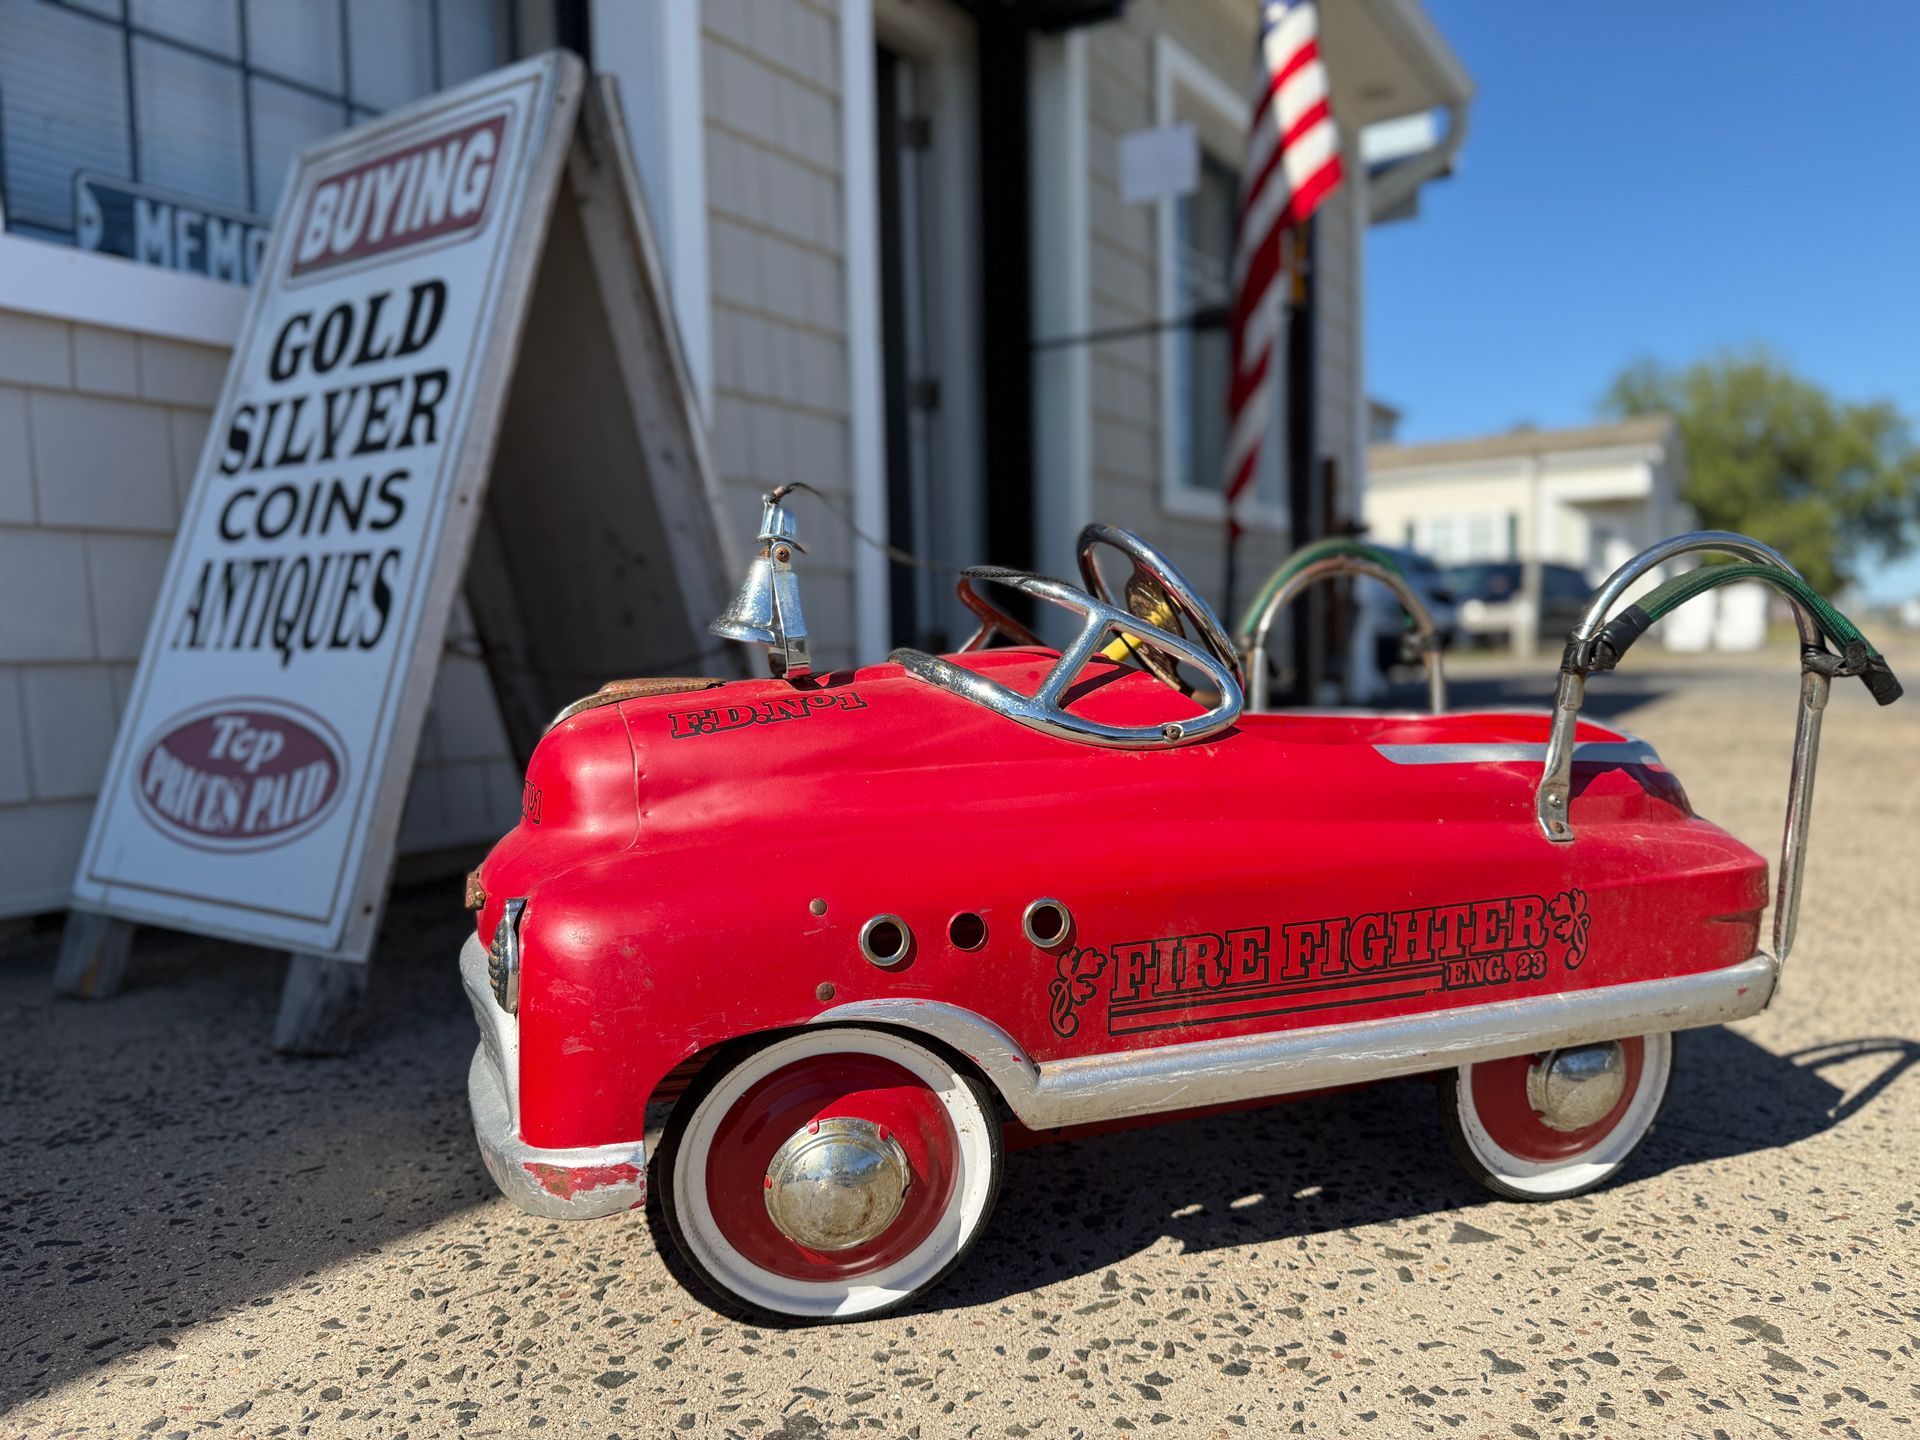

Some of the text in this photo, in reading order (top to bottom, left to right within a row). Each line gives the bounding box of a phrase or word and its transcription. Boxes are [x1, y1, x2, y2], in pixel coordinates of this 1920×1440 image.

[299, 127, 497, 264] BUYING
[269, 278, 447, 384] GOLD
[219, 368, 450, 475] SILVER
[219, 470, 409, 543] COINS
[171, 548, 402, 668] ANTIQUES
[208, 716, 285, 772] Top
[245, 760, 332, 832] PAID
[1109, 895, 1550, 1000] FIRE FIGHTER
[1443, 951, 1548, 990] ENG. 23
